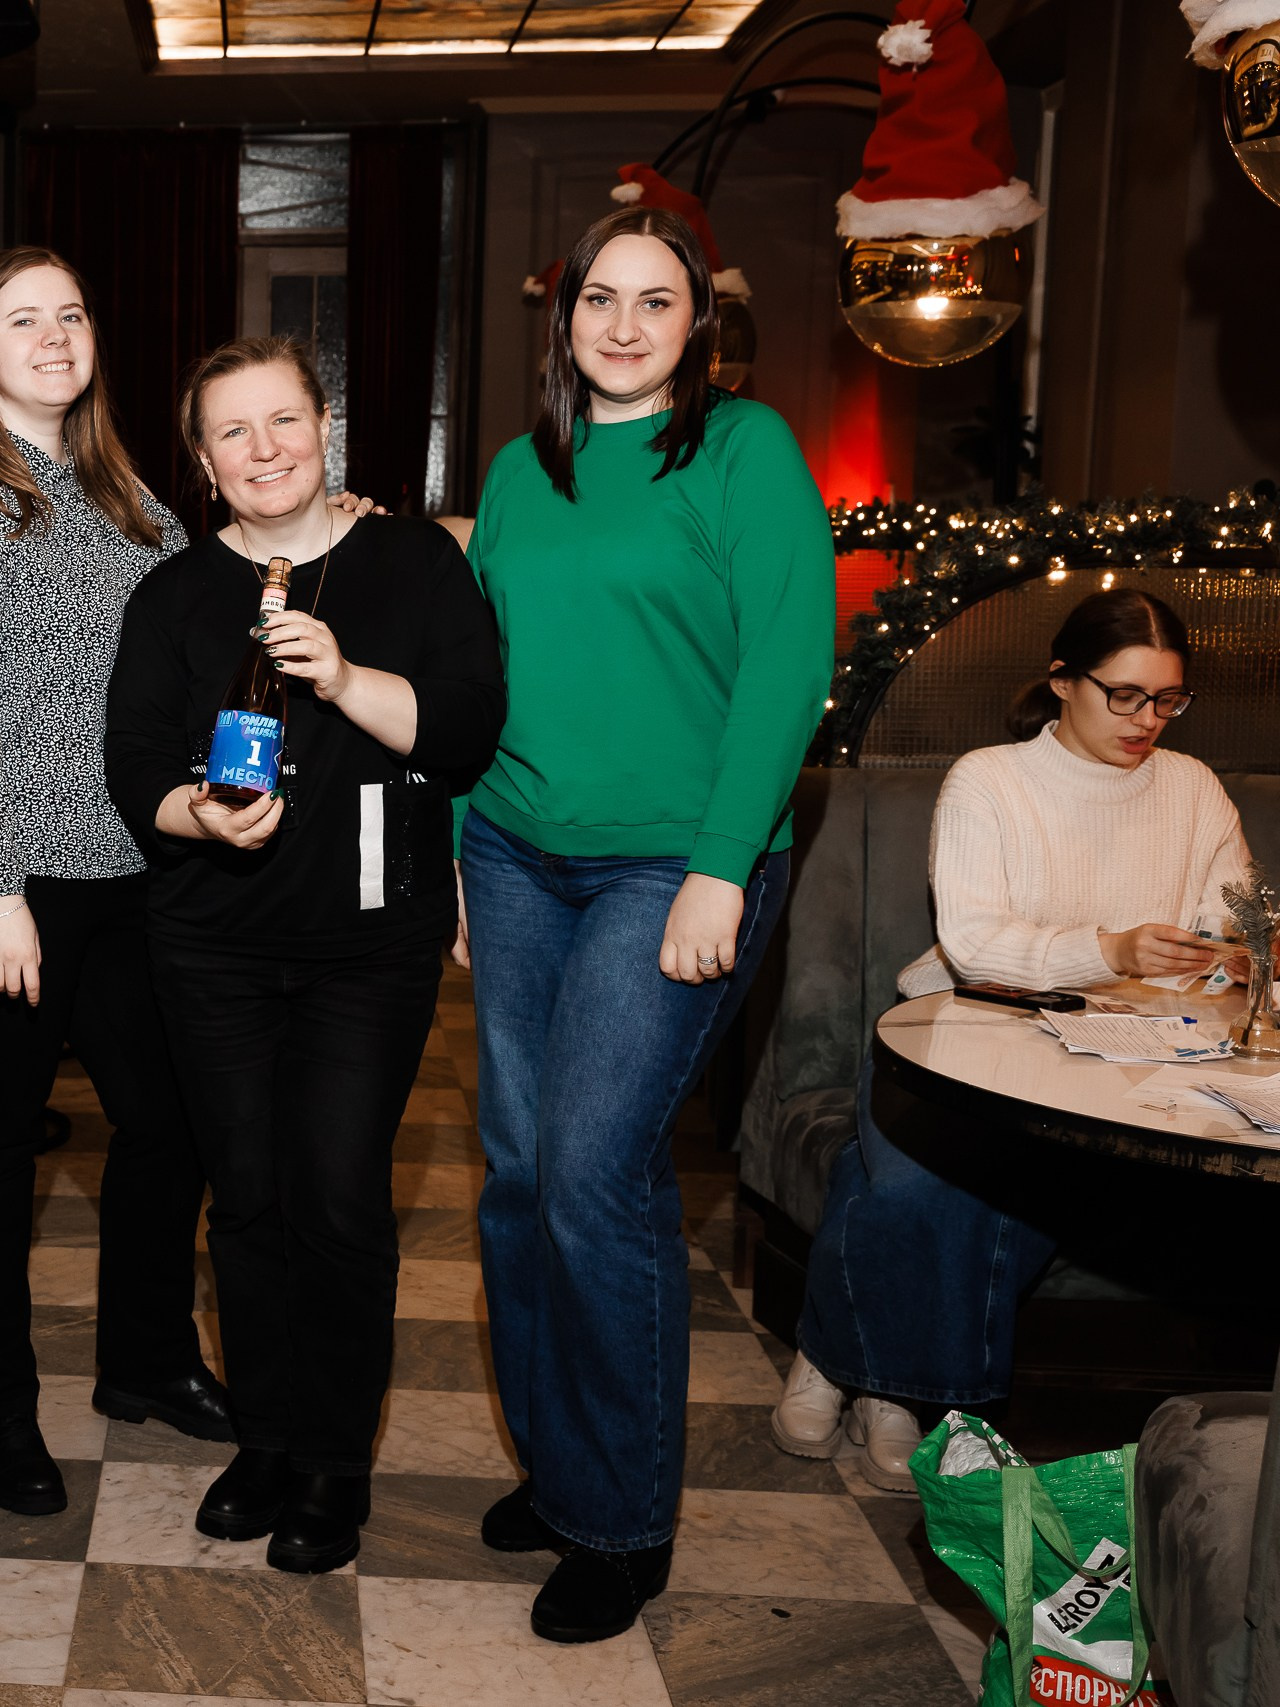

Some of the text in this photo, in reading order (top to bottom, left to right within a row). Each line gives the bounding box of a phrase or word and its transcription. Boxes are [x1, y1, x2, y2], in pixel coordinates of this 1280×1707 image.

[238, 714, 278, 730] ОНЛИ
[244, 726, 279, 740] MUSIC
[246, 739, 262, 767] 1
[221, 765, 274, 790] МЕСТО
[282, 764, 297, 775] NG
[1046, 1576, 1111, 1635] LEROY
